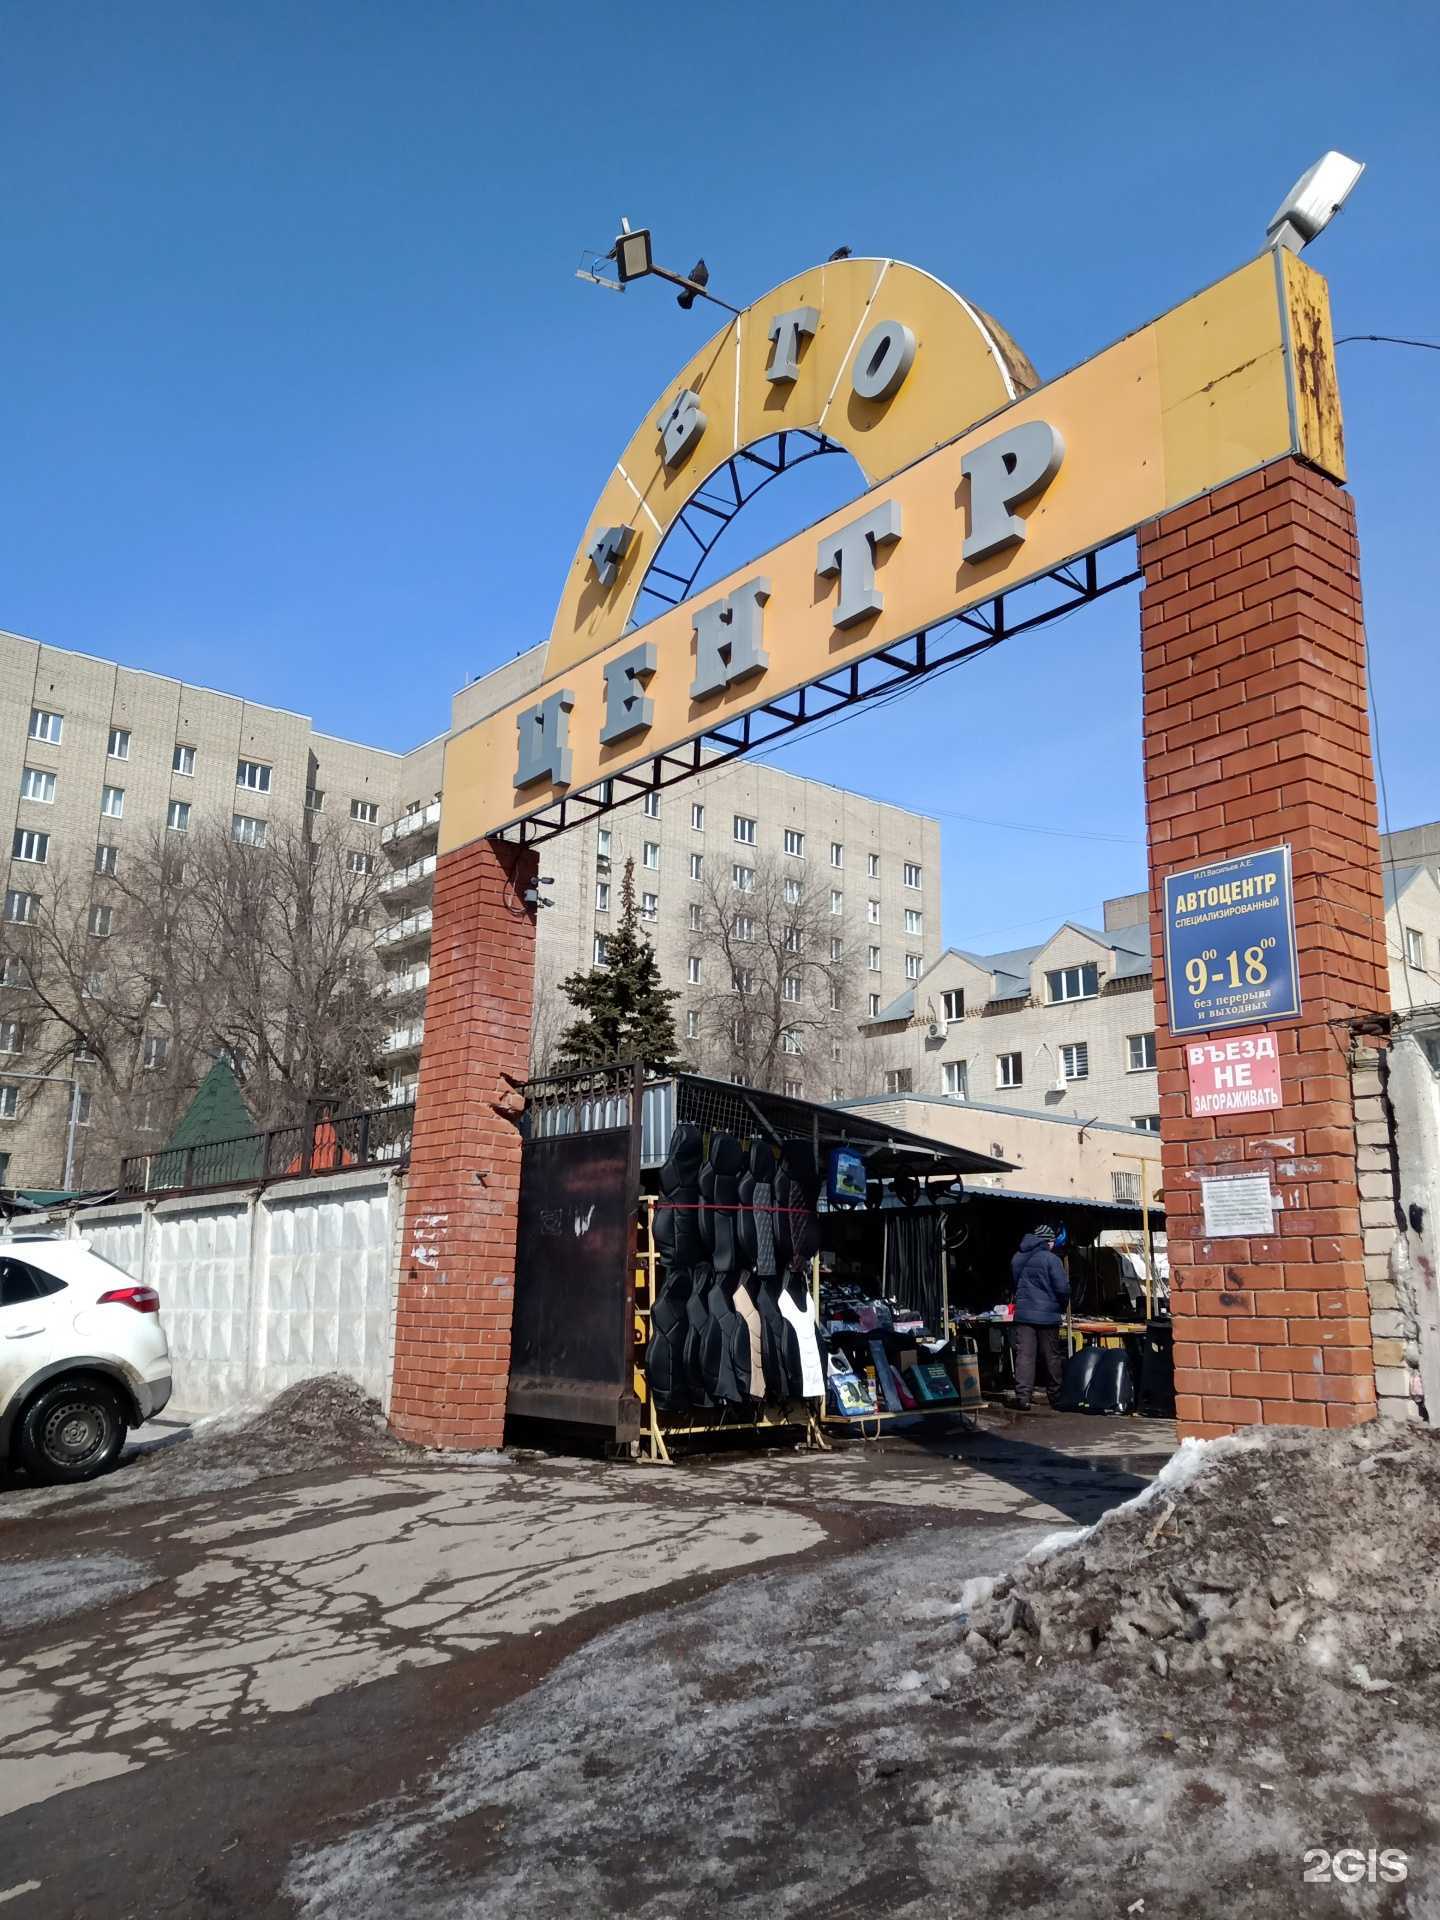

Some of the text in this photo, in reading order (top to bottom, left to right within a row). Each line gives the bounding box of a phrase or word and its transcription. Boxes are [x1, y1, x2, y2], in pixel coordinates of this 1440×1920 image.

[586, 306, 916, 586] АВТО
[513, 420, 1066, 791] ЦЕНТР
[1175, 873, 1277, 914] АВТОЦЕНТР
[1175, 896, 1280, 928] СПЕЦИАЛИЗИРОВАННЫЙ
[1193, 989, 1272, 1009] без перерыва
[1198, 1001, 1268, 1020] и выходных
[1190, 1037, 1275, 1066] ВЪЕЗД
[1214, 1063, 1253, 1089] НЕ
[1194, 1087, 1279, 1113] ЗАГОРАЖИВАТЬ
